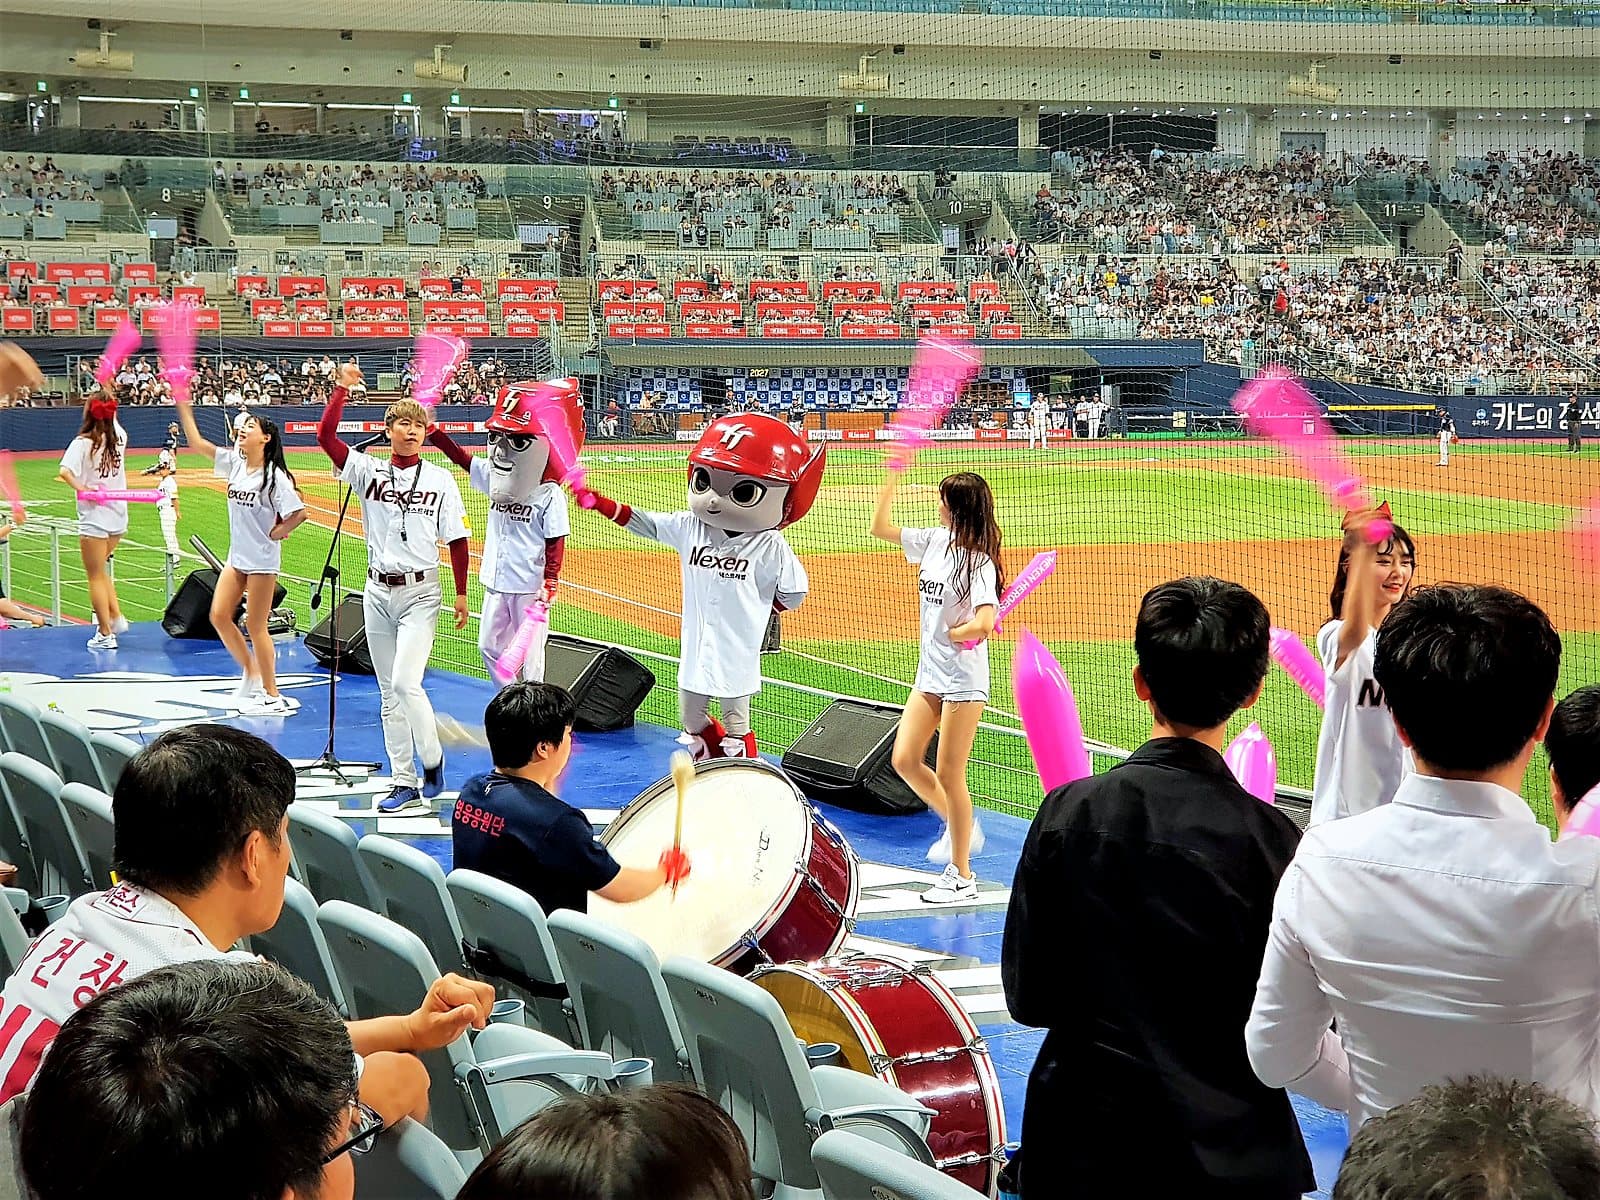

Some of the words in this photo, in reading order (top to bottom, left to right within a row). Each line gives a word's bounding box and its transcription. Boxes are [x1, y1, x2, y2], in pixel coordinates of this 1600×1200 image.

[162, 187, 171, 202] 8
[543, 195, 552, 210] 9
[948, 201, 962, 214] 10
[1384, 203, 1396, 217] 11
[750, 368, 769, 377] 2027
[1492, 402, 1553, 431] 카드의
[227, 483, 256, 502] exen
[365, 478, 438, 506] Nexen
[688, 545, 749, 572] Nexen
[998, 579, 1030, 612] HEROES
[454, 799, 506, 838] 영웅응원단
[30, 937, 129, 1009] 건창
